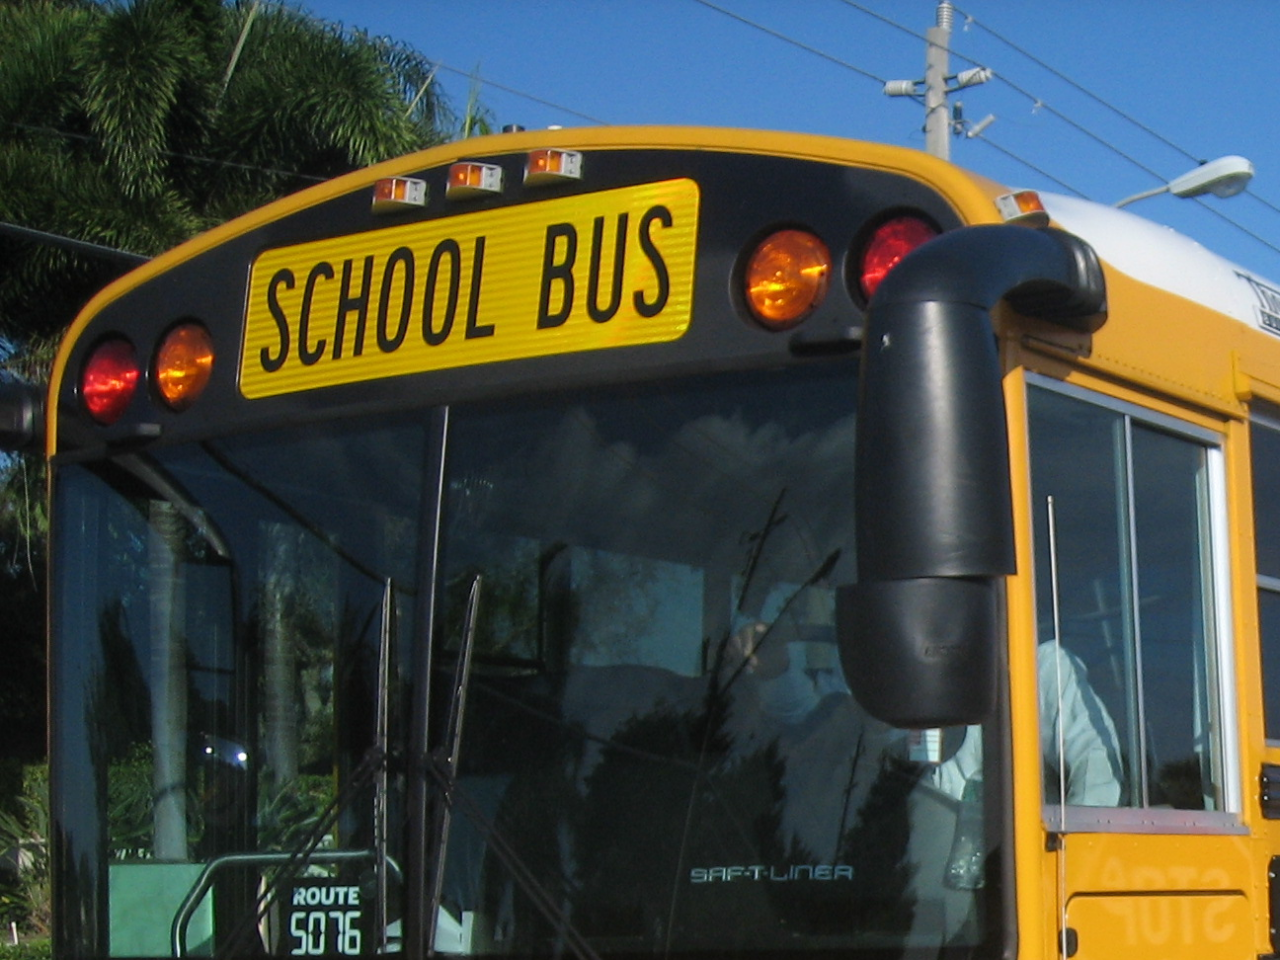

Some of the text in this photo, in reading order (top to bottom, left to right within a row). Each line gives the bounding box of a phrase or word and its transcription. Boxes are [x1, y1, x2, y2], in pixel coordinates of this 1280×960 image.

[260, 204, 673, 373] SCHOOL BUS
[292, 886, 360, 906] ROUTE
[290, 910, 361, 956] 5076
